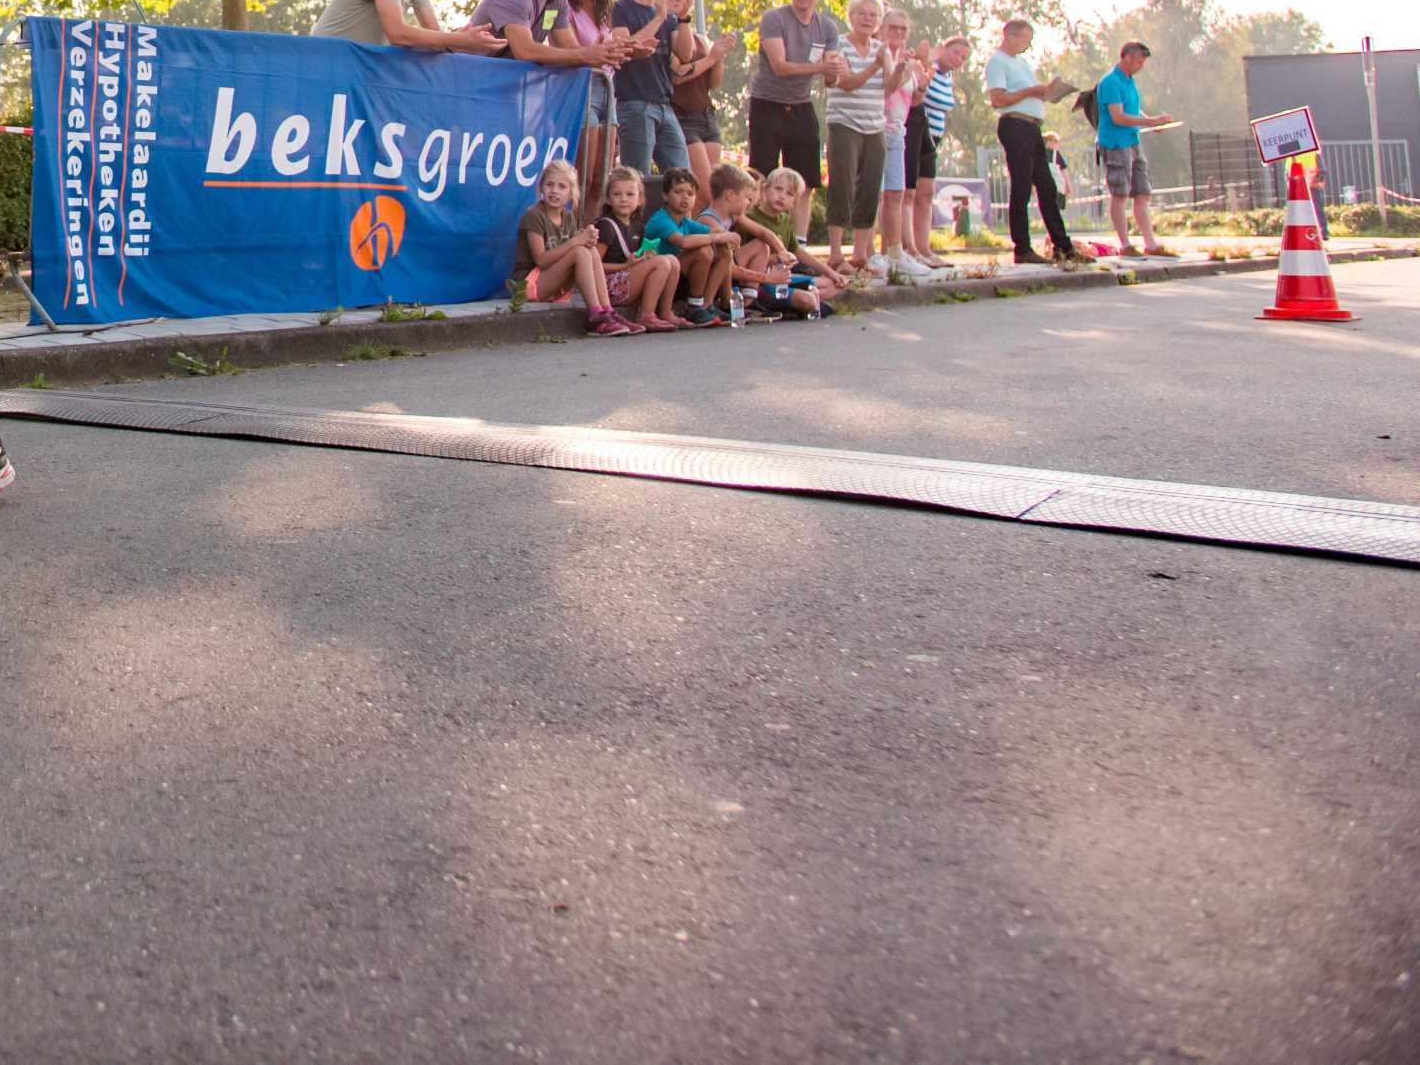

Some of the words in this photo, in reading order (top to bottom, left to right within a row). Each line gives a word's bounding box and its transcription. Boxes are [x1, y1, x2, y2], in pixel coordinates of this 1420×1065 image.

[66, 19, 92, 305] Verzekeringen
[97, 22, 125, 256] Hypotheken
[124, 25, 157, 256] Makelaardij
